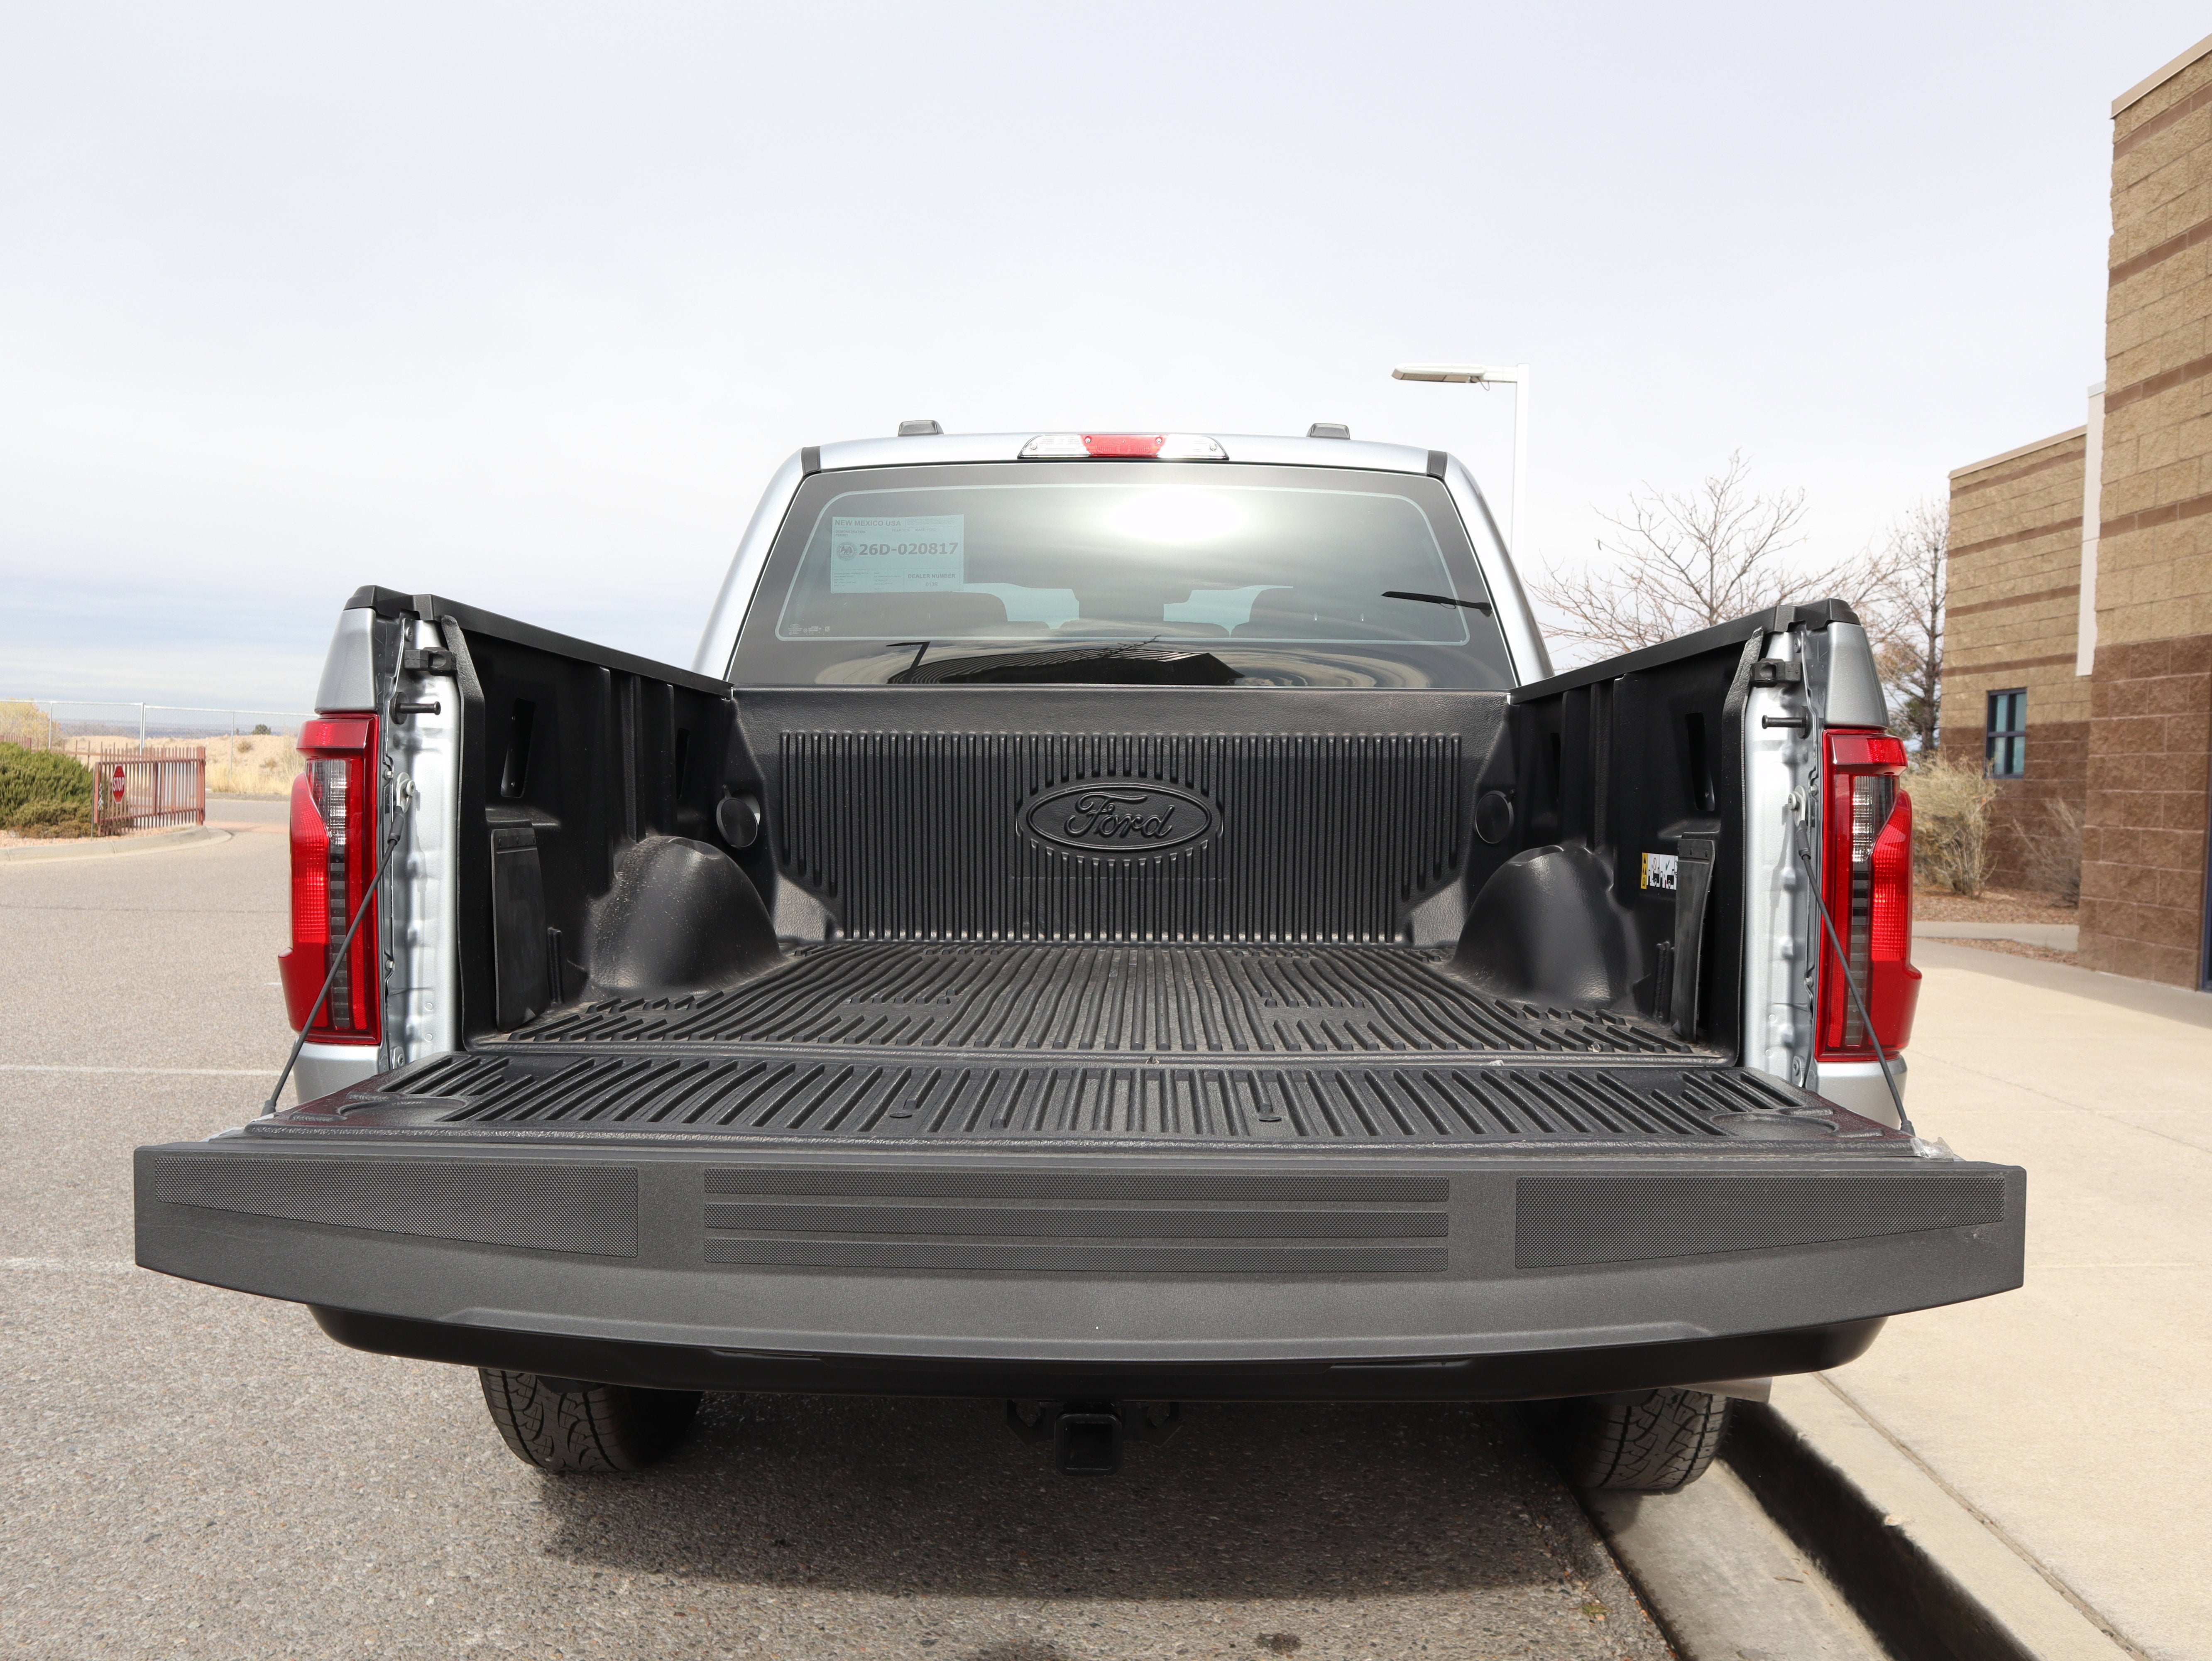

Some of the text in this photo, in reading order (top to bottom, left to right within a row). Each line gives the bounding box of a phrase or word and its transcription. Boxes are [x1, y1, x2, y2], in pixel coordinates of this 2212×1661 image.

[859, 542, 958, 556] 26D-020817
[113, 777, 125, 791] STOP
[1064, 791, 1175, 839] Ford
